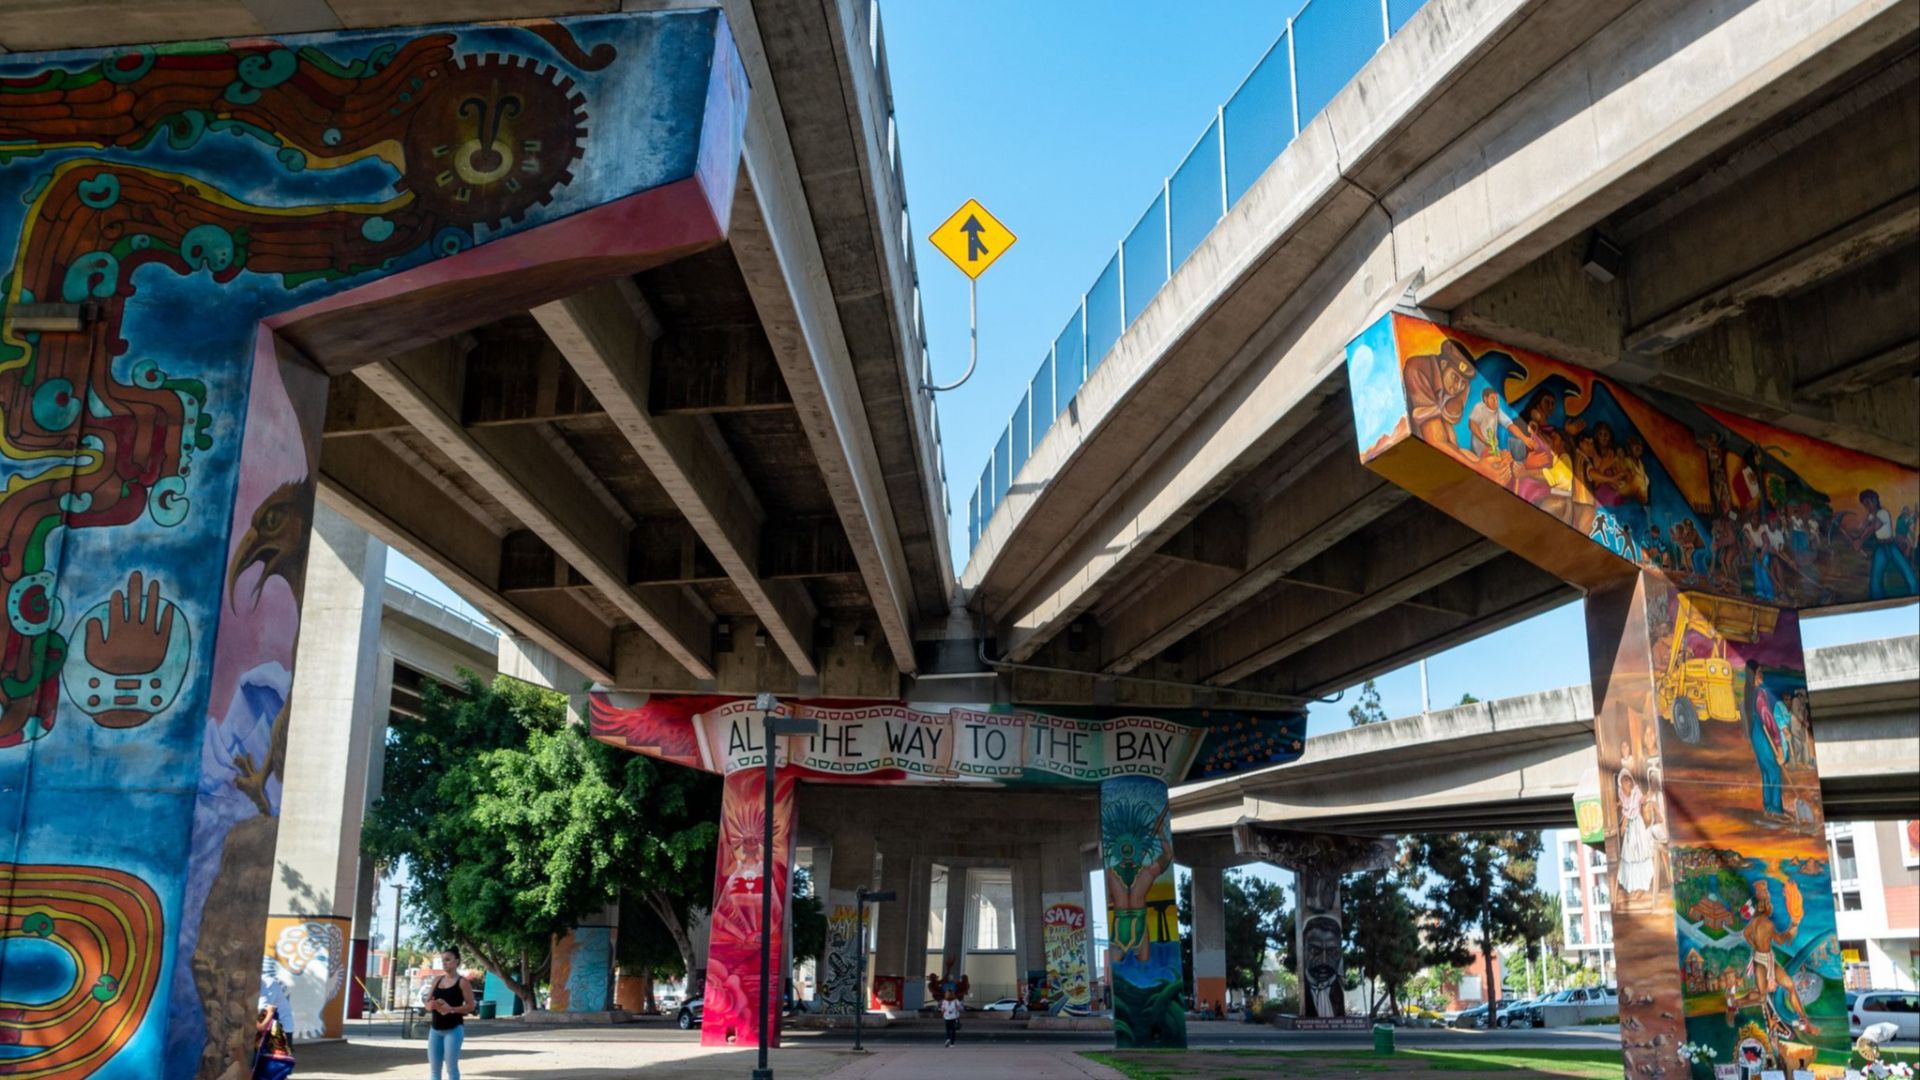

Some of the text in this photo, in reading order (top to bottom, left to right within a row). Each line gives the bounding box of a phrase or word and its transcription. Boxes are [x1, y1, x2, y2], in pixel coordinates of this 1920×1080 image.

[728, 717, 781, 756] AL
[885, 721, 943, 760] WAY
[965, 724, 1006, 761] TO
[1030, 724, 1088, 766] THE
[1115, 731, 1173, 764] BAY
[826, 914, 852, 940] WHY
[1044, 907, 1084, 926] SAVE
